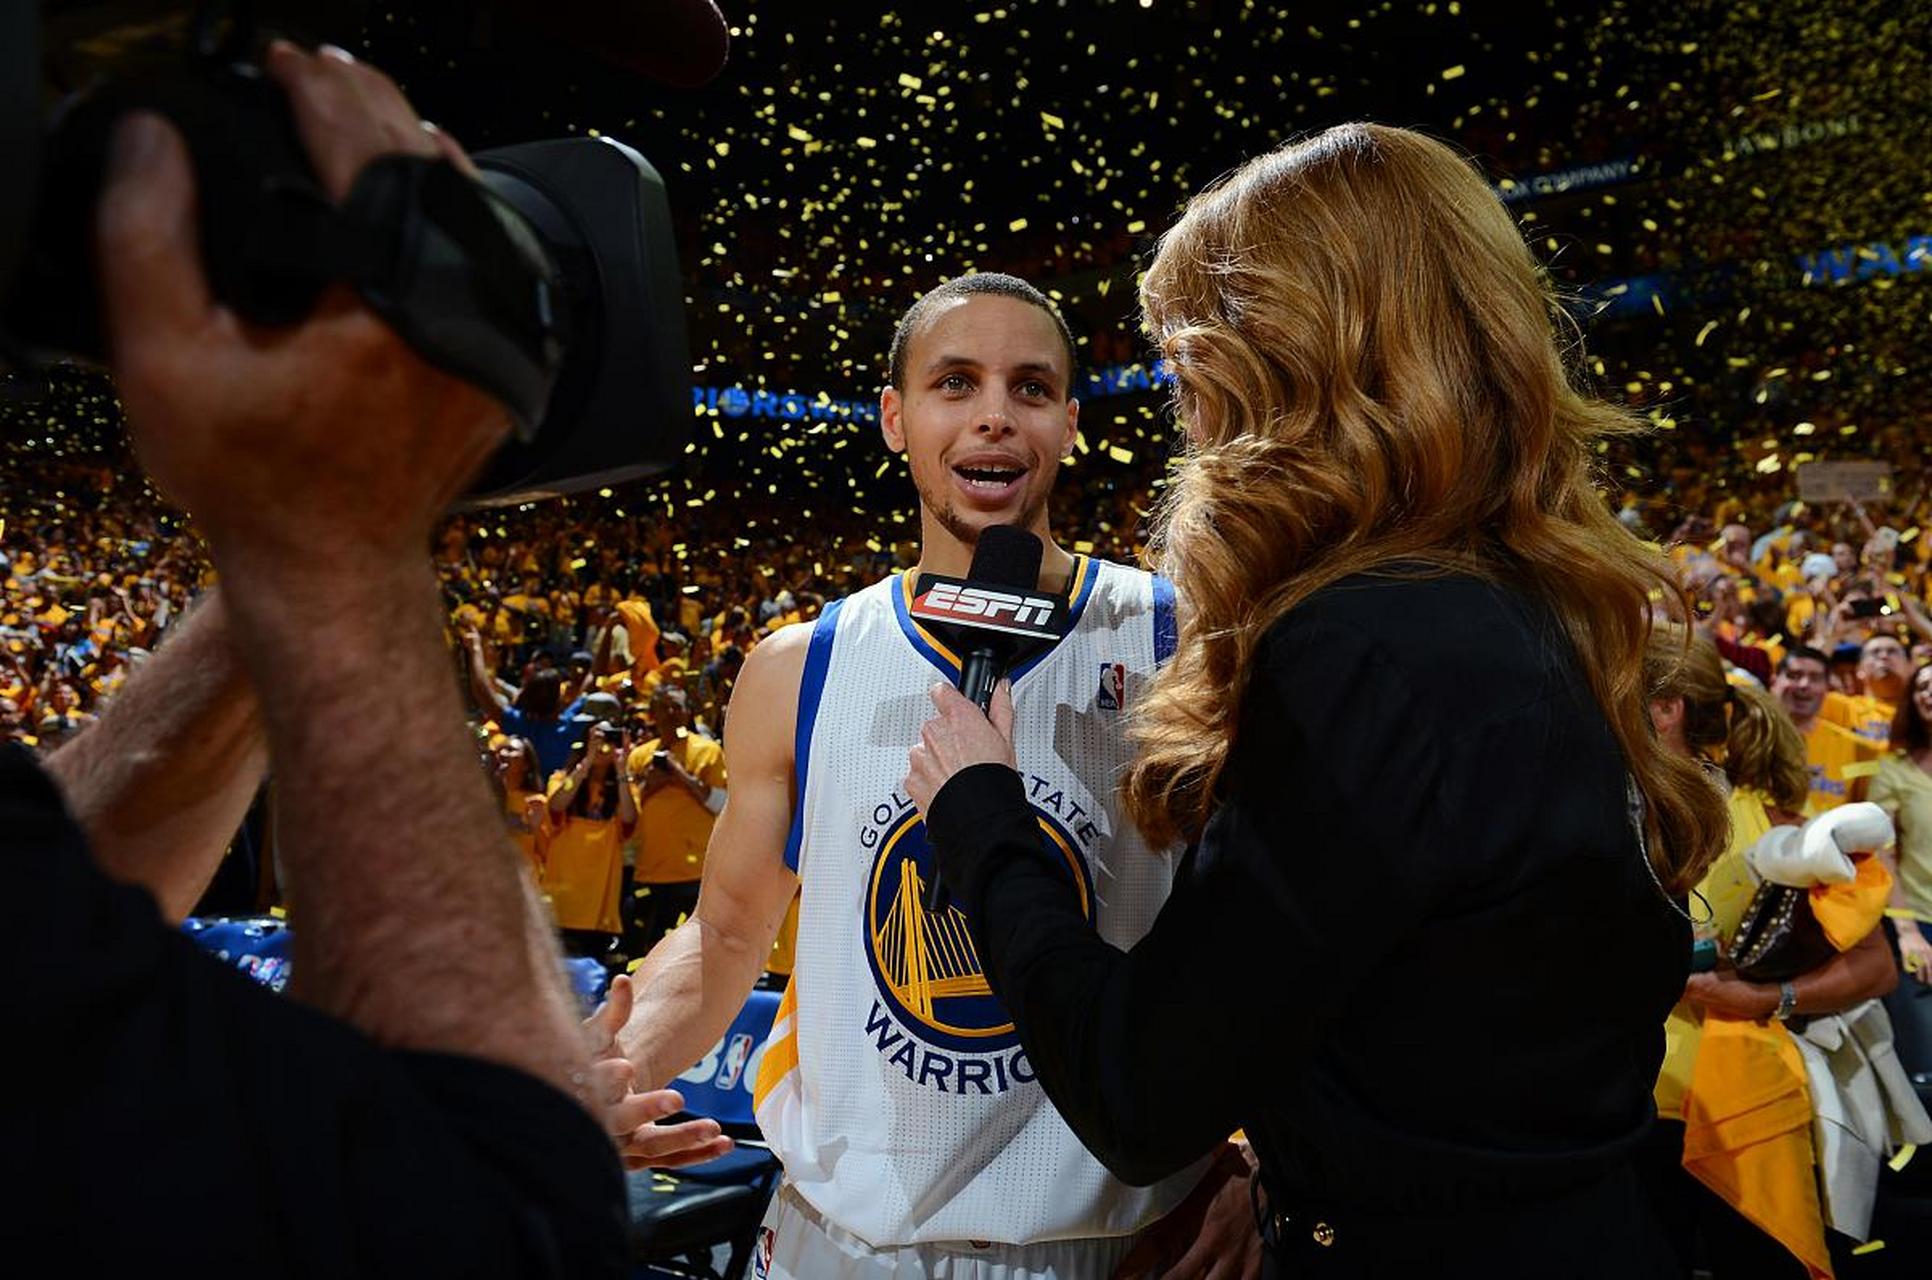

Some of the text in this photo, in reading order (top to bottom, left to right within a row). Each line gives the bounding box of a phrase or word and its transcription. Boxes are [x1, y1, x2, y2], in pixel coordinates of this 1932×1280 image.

[923, 582, 1056, 626] ESPN
[860, 771, 1101, 849] GOL TATE
[864, 999, 1036, 1096] WARRIO
